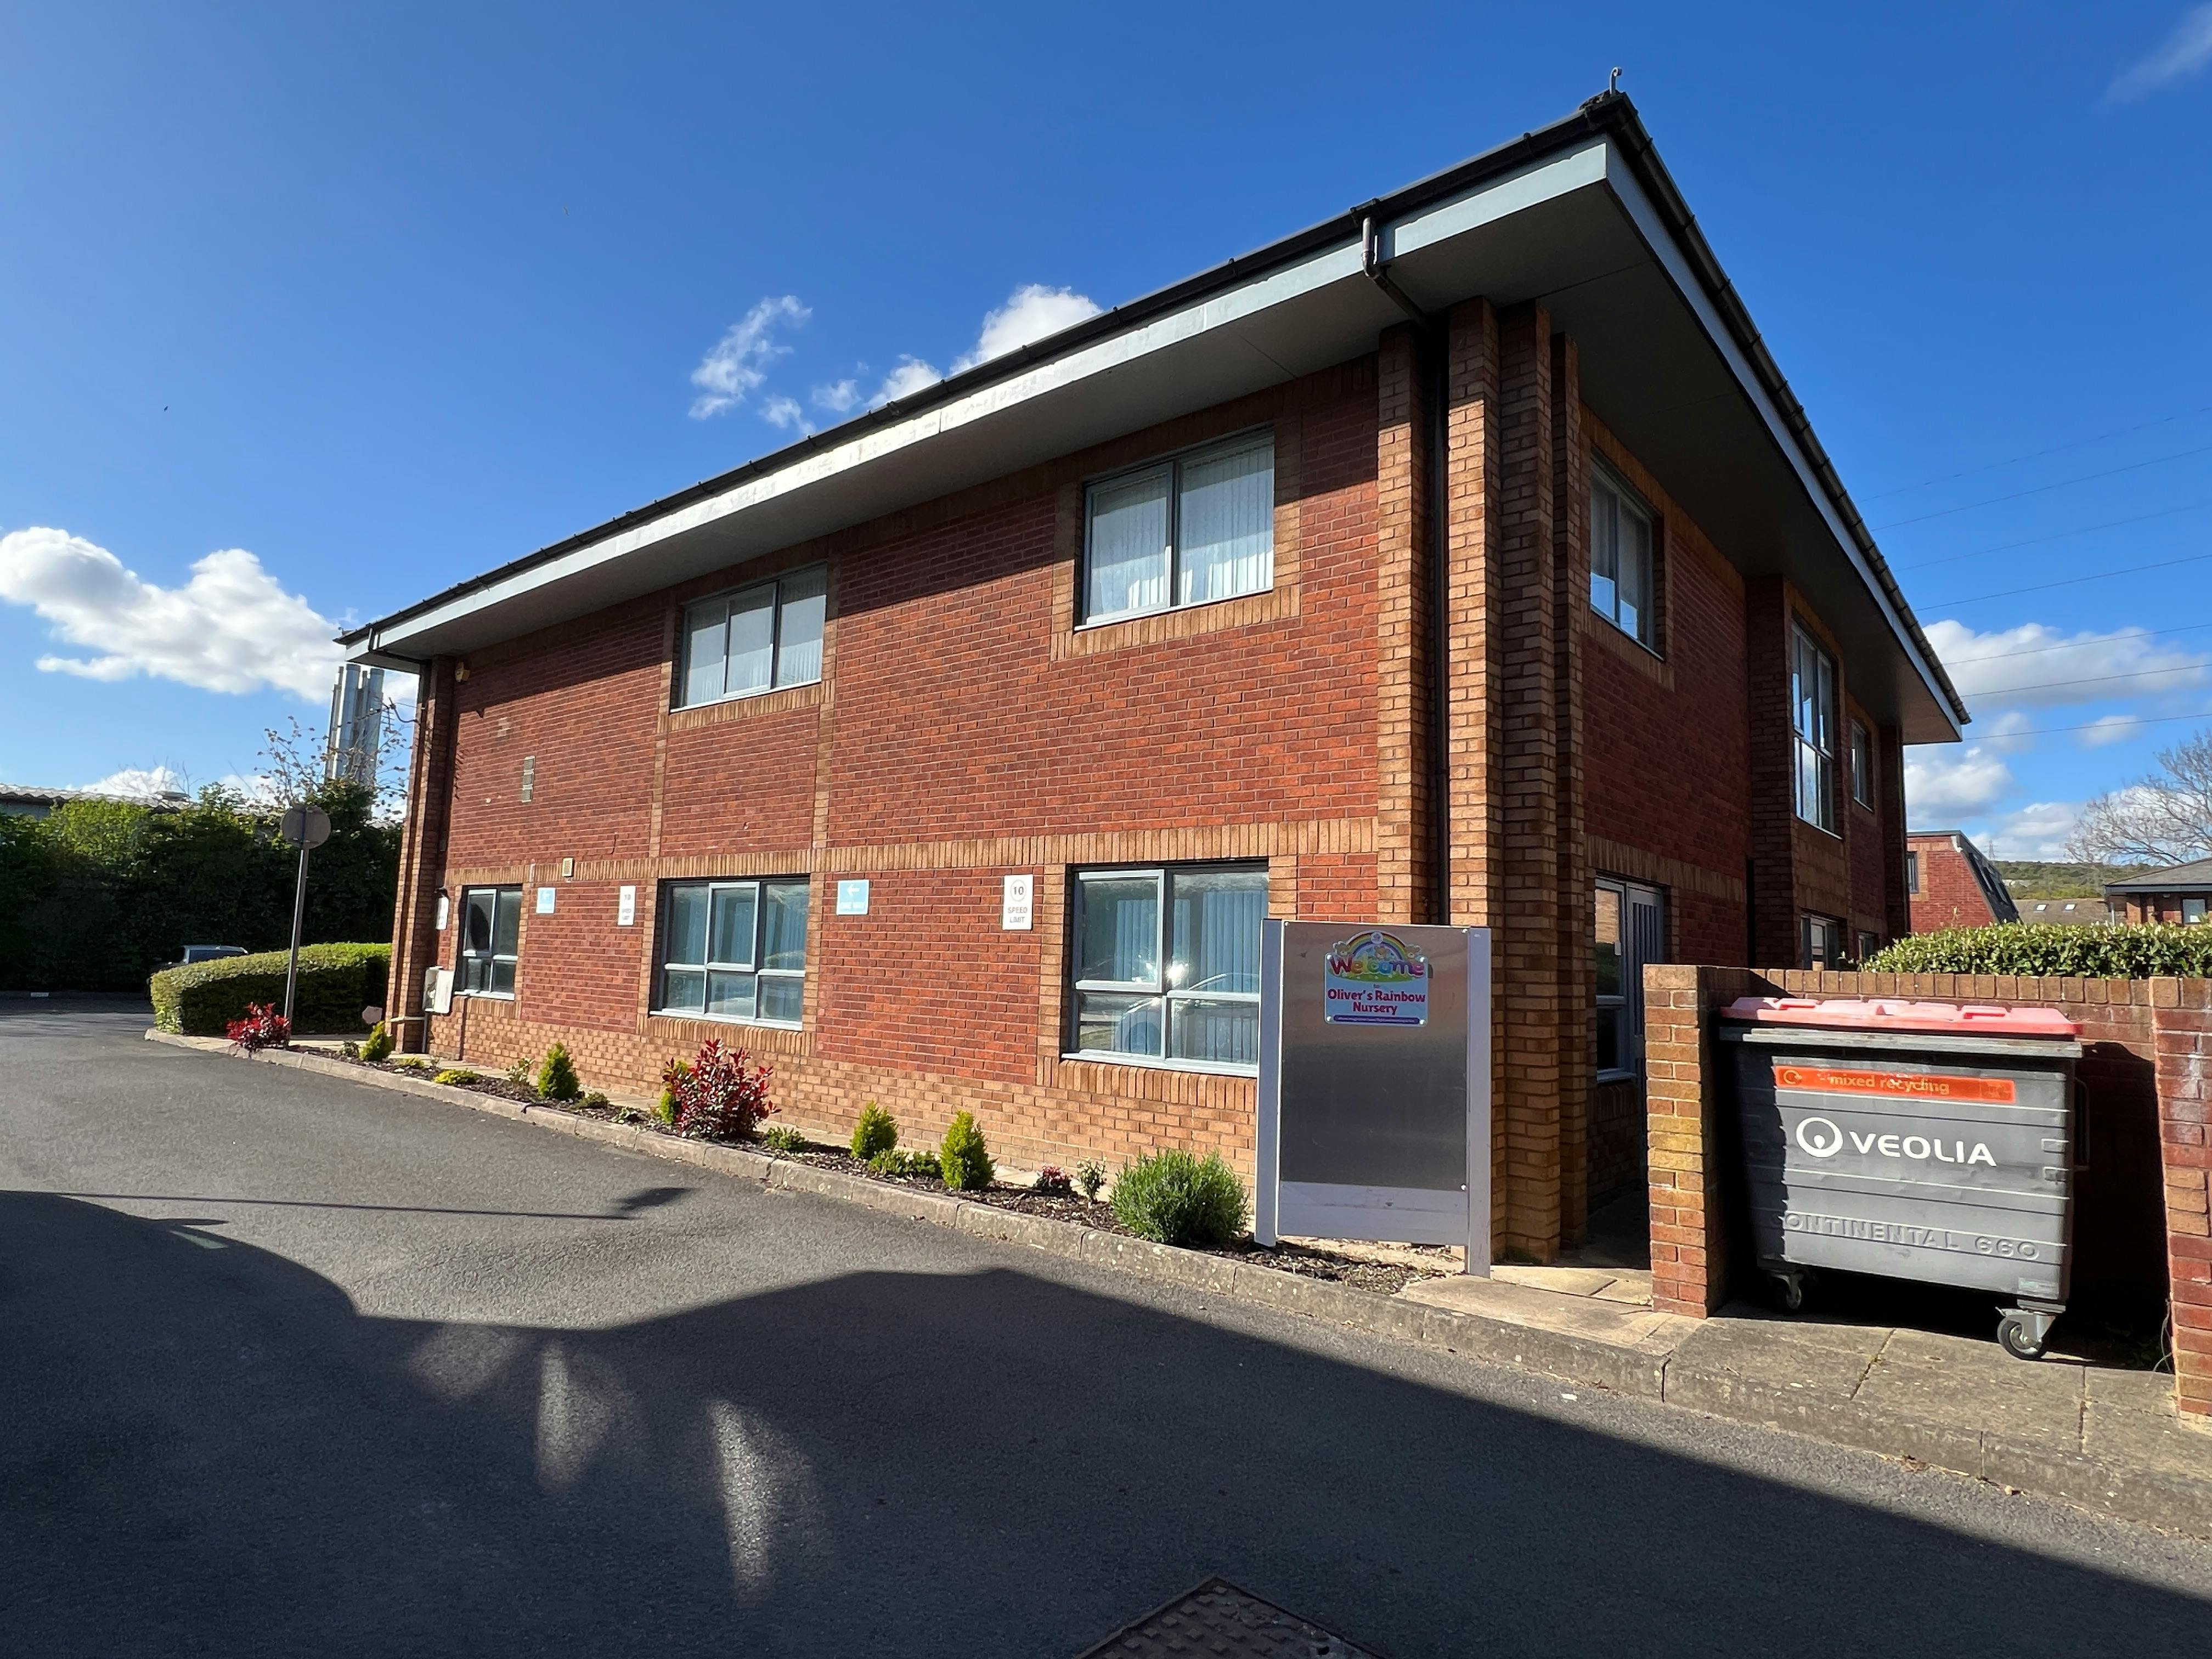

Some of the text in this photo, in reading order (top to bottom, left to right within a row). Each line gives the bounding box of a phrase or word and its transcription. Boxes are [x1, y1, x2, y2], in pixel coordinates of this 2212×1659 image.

[1013, 887, 1024, 895] 10
[1329, 953, 1425, 976] Welcome
[1328, 989, 1426, 1002] Oliver's Rainbow
[1353, 1002, 1398, 1015] Nursery
[1829, 1074, 1950, 1095] mixed recycling
[1849, 1131, 1997, 1167] VEOLIA
[1974, 1236, 2040, 1261] 660
